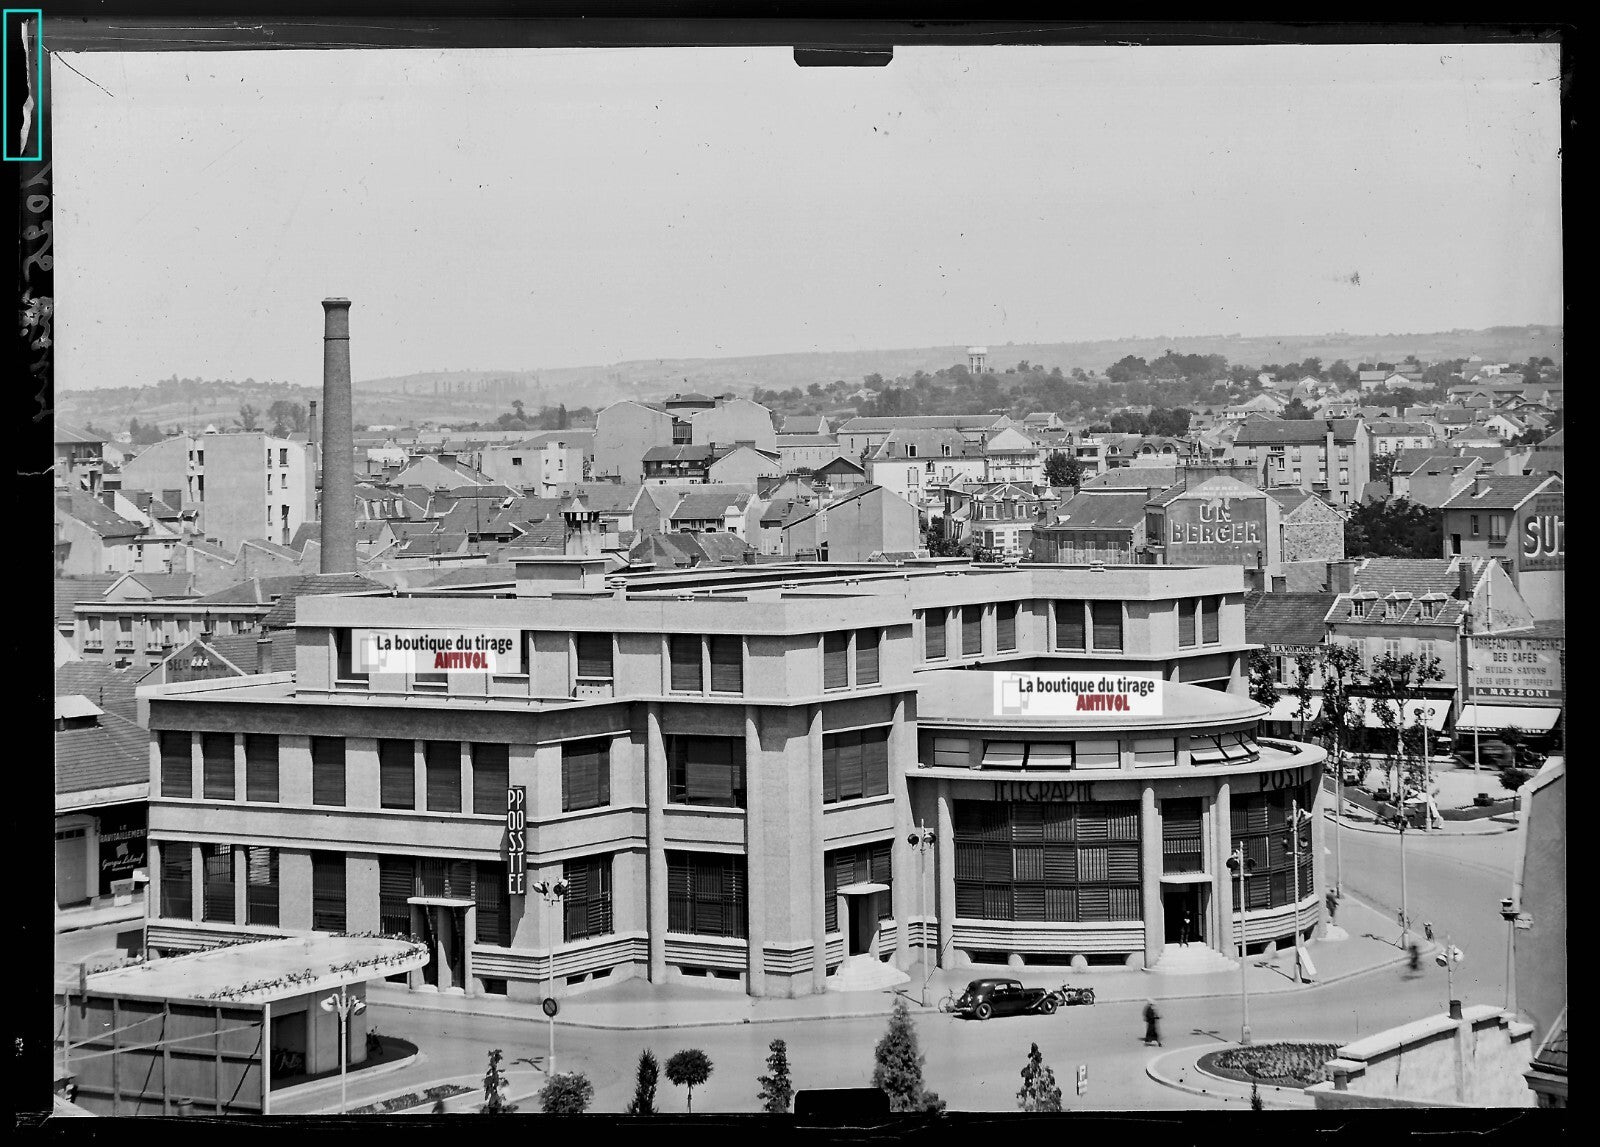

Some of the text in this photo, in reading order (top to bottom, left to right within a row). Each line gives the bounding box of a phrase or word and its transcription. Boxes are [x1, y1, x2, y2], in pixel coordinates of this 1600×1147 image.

[1200, 500, 1231, 522] UN
[1169, 519, 1261, 545] BERGER
[1493, 652, 1507, 662] DES
[1485, 666, 1547, 675] HUILES SAVONS
[1490, 688, 1550, 698] MAZZONI
[507, 789, 516, 894] POSTE
[516, 789, 524, 895] POSTE
